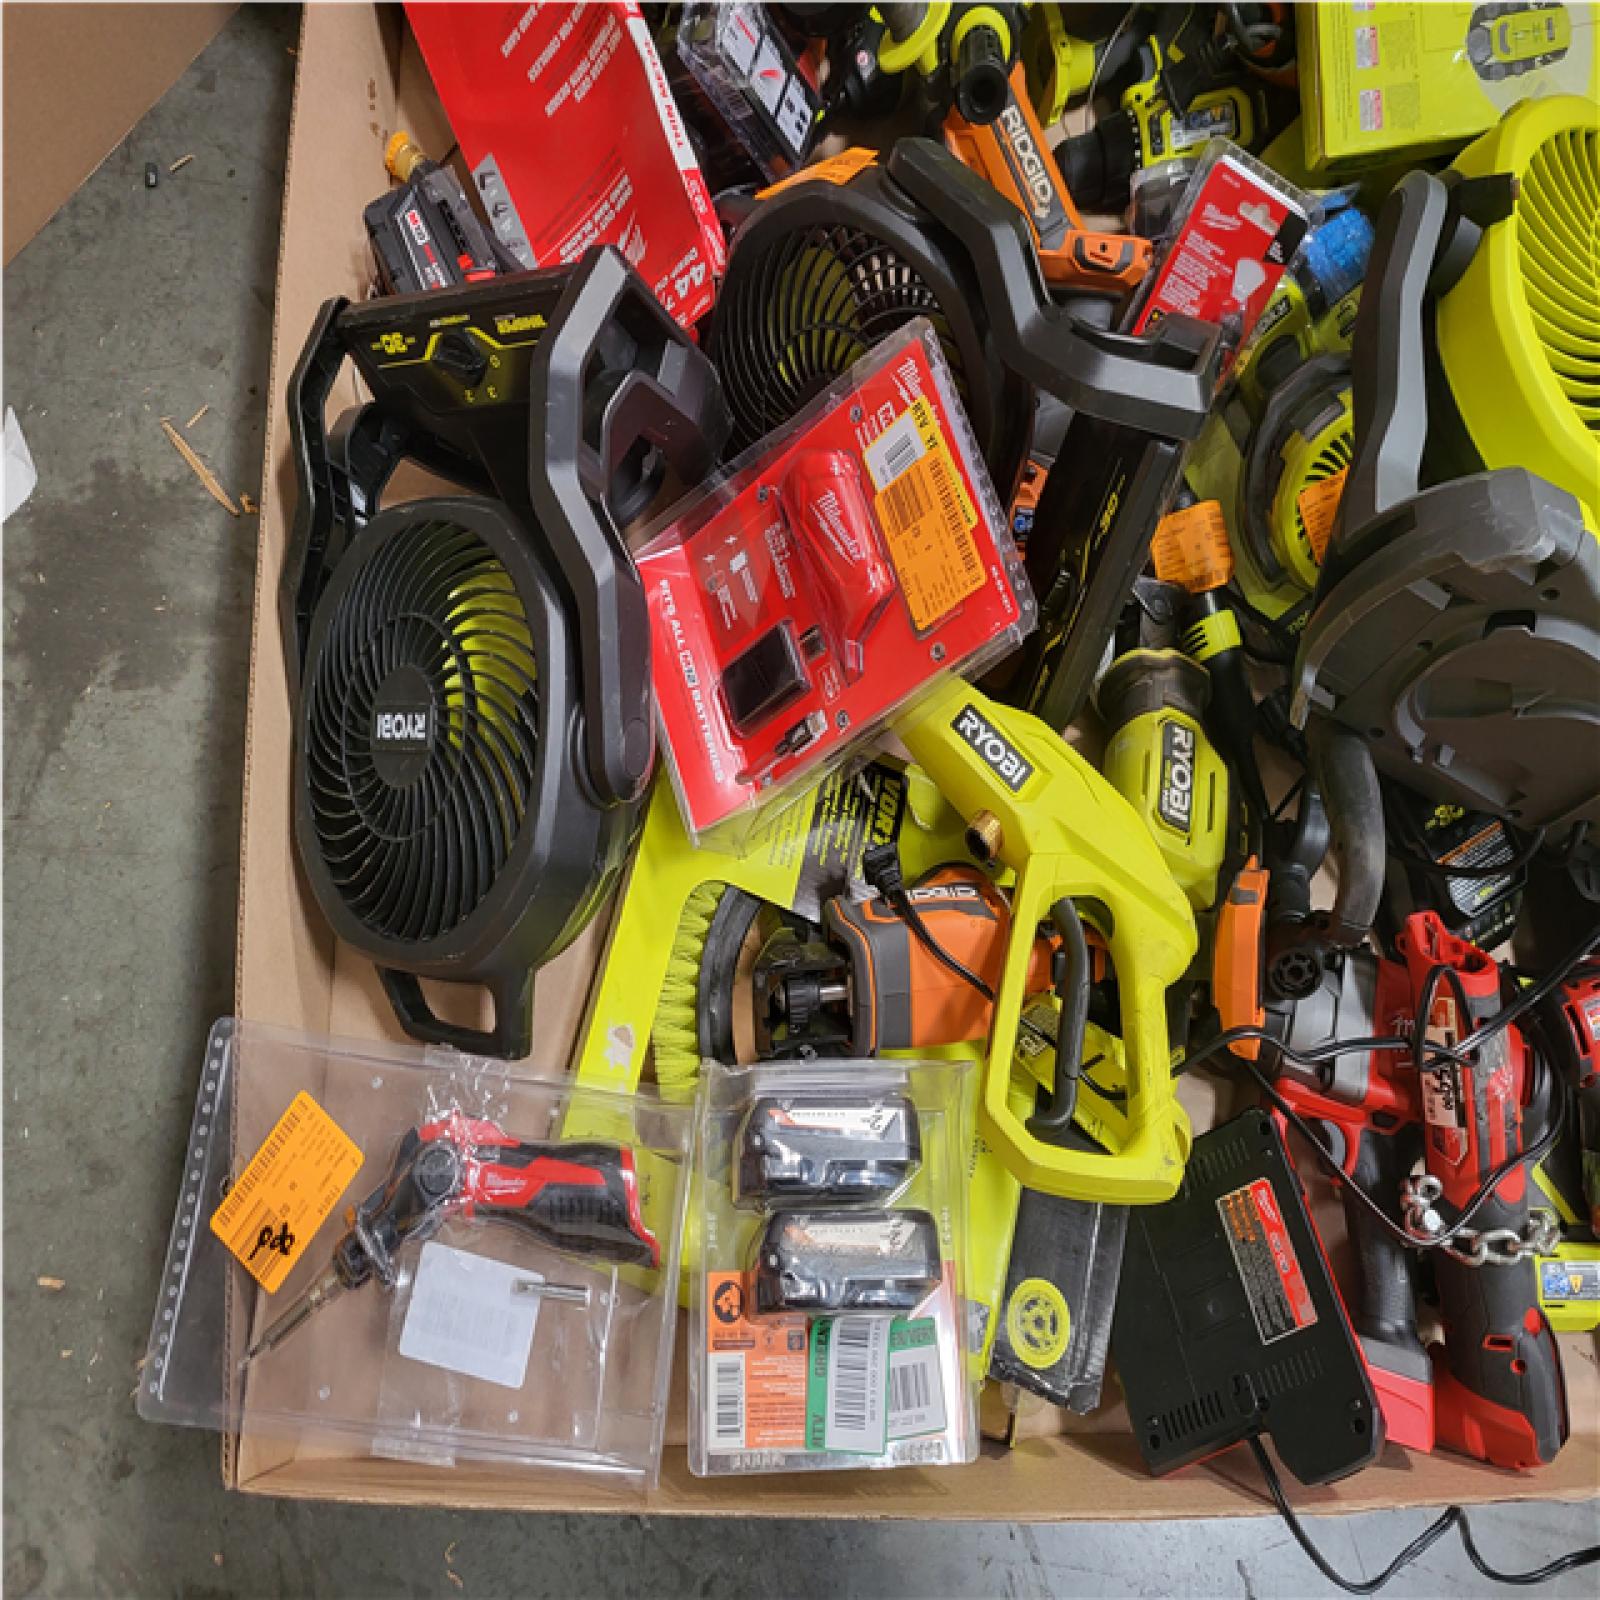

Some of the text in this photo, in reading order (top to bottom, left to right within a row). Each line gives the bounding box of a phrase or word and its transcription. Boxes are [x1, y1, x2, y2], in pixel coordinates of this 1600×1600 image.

[642, 39, 685, 149] THIN METAL
[1001, 105, 1053, 219] RIDGID
[377, 712, 426, 740] RYOBI
[659, 578, 676, 616] FITS
[671, 618, 686, 649] ALL
[692, 689, 726, 783] BATTERIES
[959, 716, 1028, 782] RYOBI
[1168, 726, 1194, 823] RYOBI
